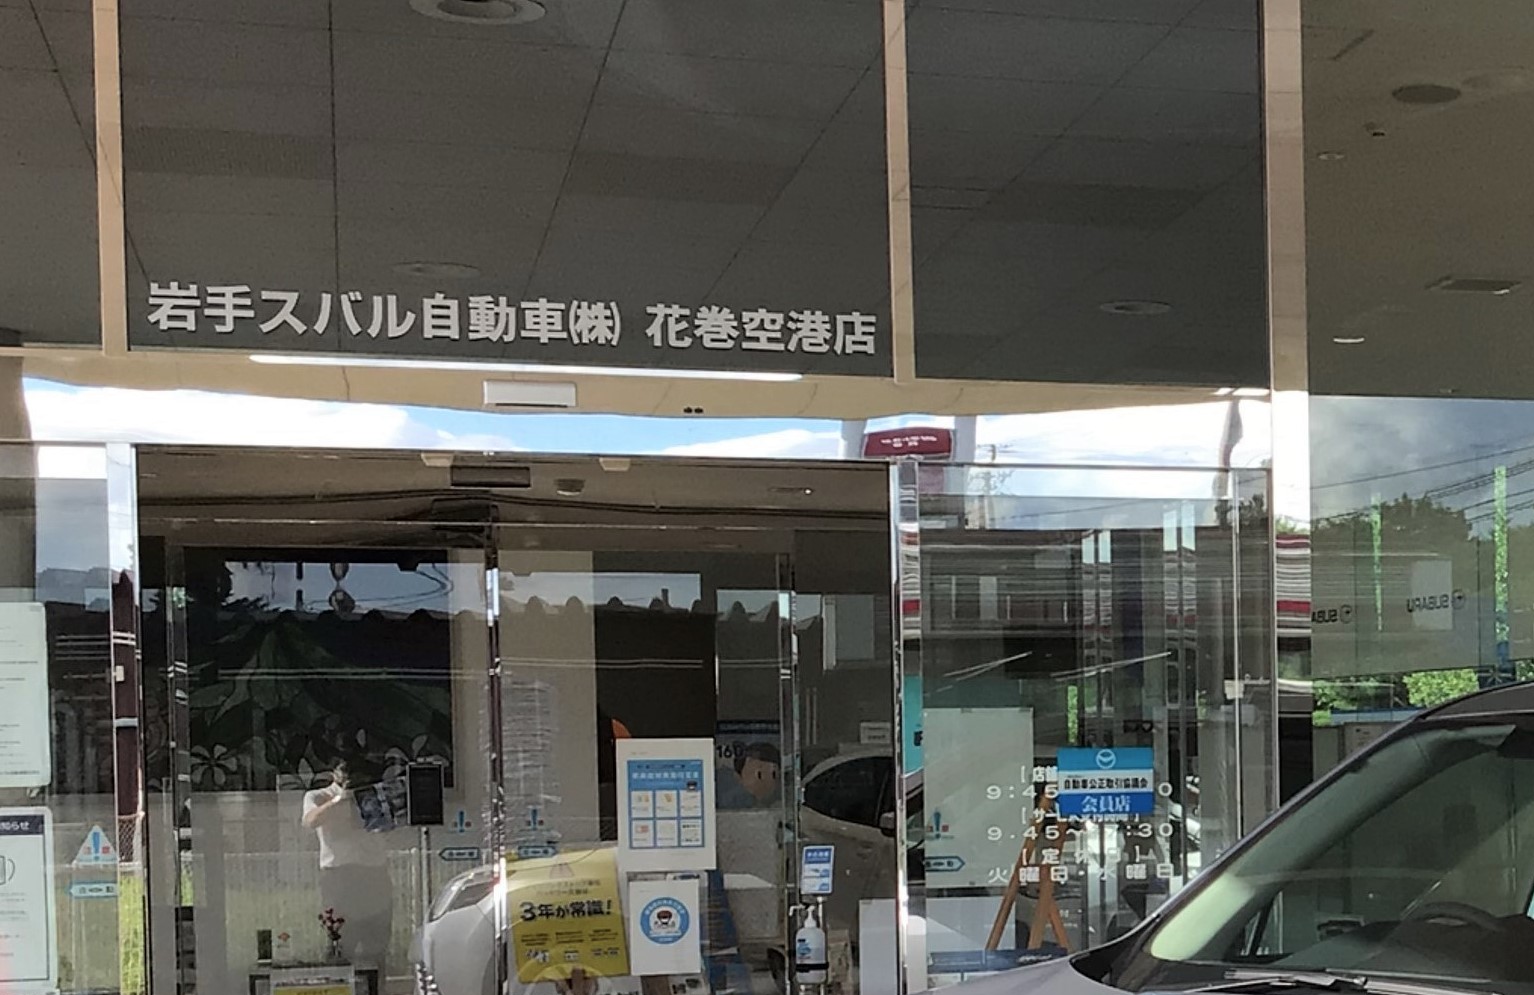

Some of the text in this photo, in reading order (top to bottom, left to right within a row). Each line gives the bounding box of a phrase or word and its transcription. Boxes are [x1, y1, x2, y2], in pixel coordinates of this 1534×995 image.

[645, 303, 877, 355] 花巻空港店
[1063, 778, 1149, 790] 自動車公正取引協議会
[1081, 795, 1131, 813] 会員店
